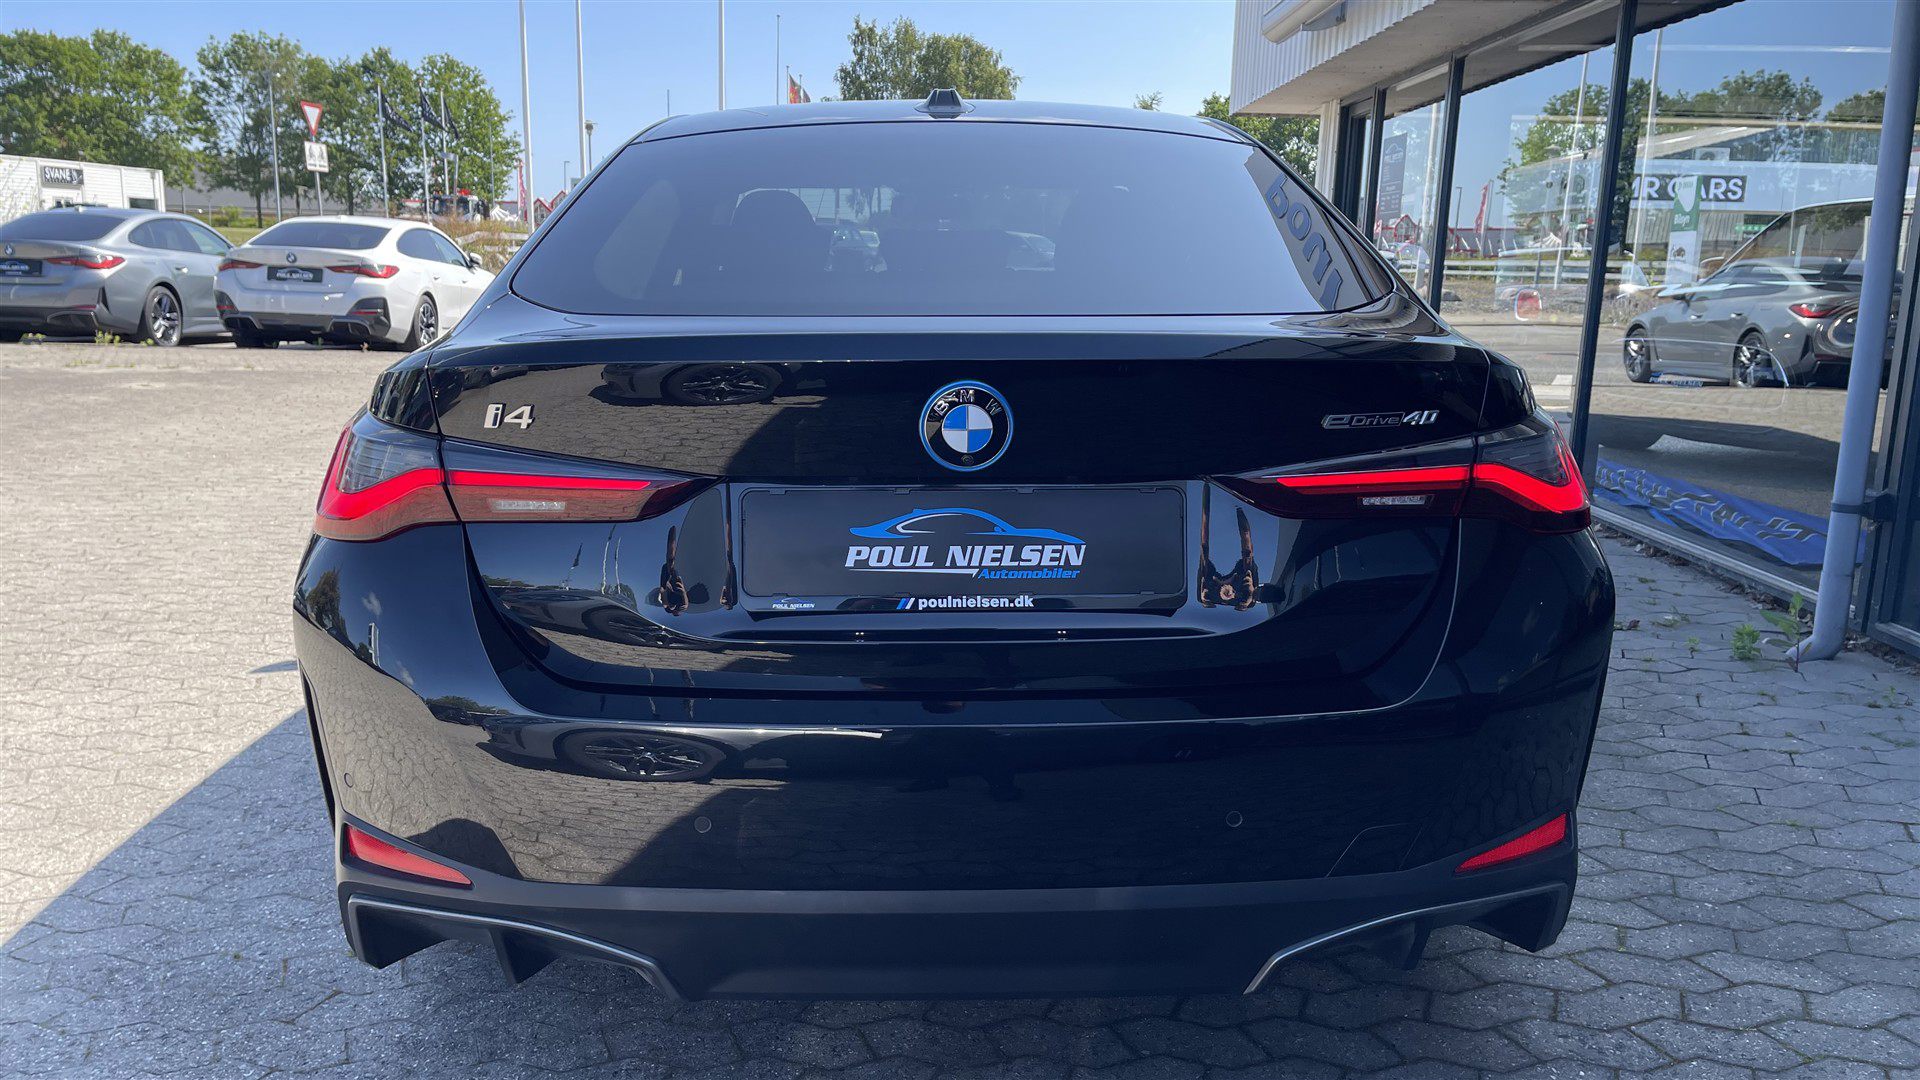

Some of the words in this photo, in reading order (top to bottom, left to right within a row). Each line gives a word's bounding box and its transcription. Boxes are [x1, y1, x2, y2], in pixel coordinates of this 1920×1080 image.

[44, 166, 71, 180] SVANE
[934, 389, 1002, 416] BMW
[483, 403, 535, 429] i4
[844, 545, 934, 567] POUL
[945, 544, 1087, 567] NIELSEN
[978, 568, 1081, 580] Automobiler
[917, 595, 1036, 610] poulnielsen.dk
